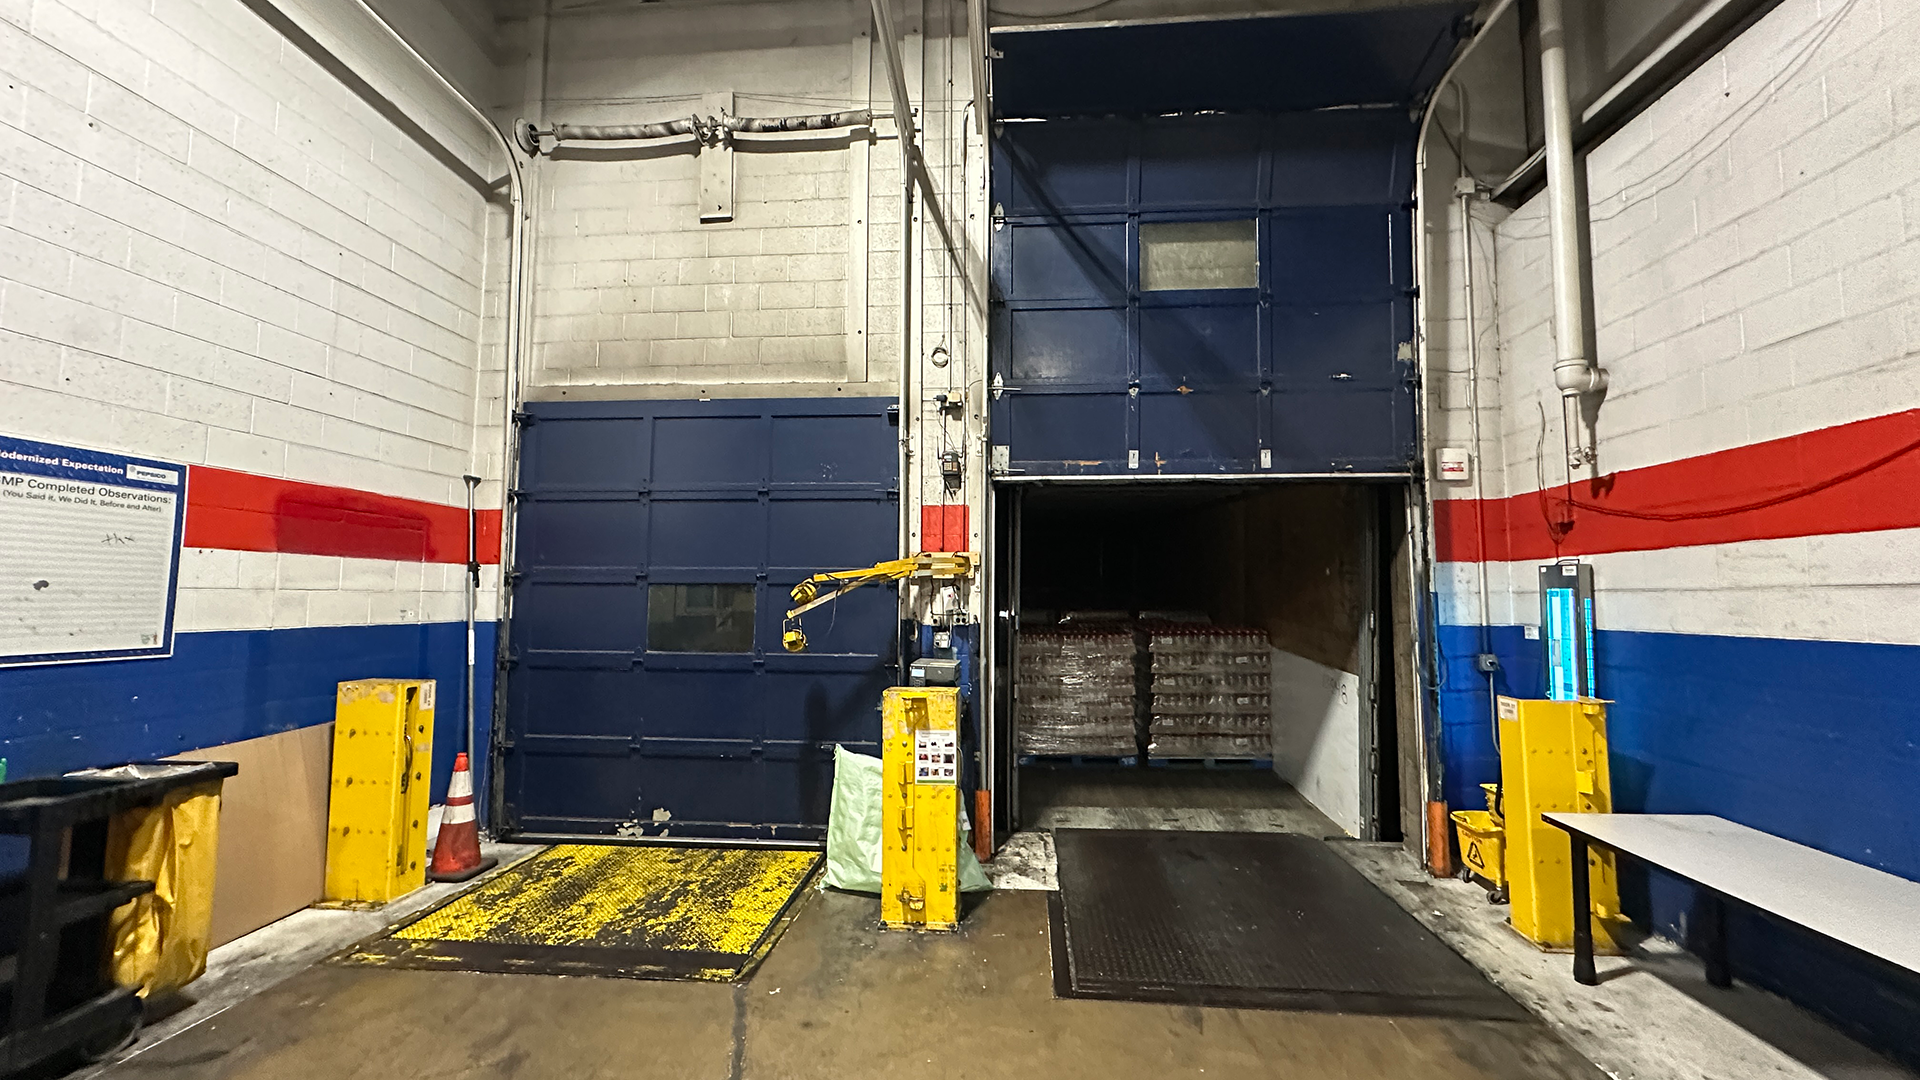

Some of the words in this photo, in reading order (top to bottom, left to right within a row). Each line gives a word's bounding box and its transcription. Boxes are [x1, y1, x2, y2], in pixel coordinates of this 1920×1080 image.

[62, 458, 124, 475] Expectation
[136, 470, 167, 479] PEPSICO
[0, 475, 24, 486] MP
[27, 478, 95, 495] Completed
[98, 487, 172, 504] Observations:
[3, 489, 24, 498] (You
[26, 491, 46, 500] Said
[58, 495, 72, 503] We
[99, 499, 125, 508] Before
[126, 502, 140, 510] and
[142, 504, 162, 513] After)
